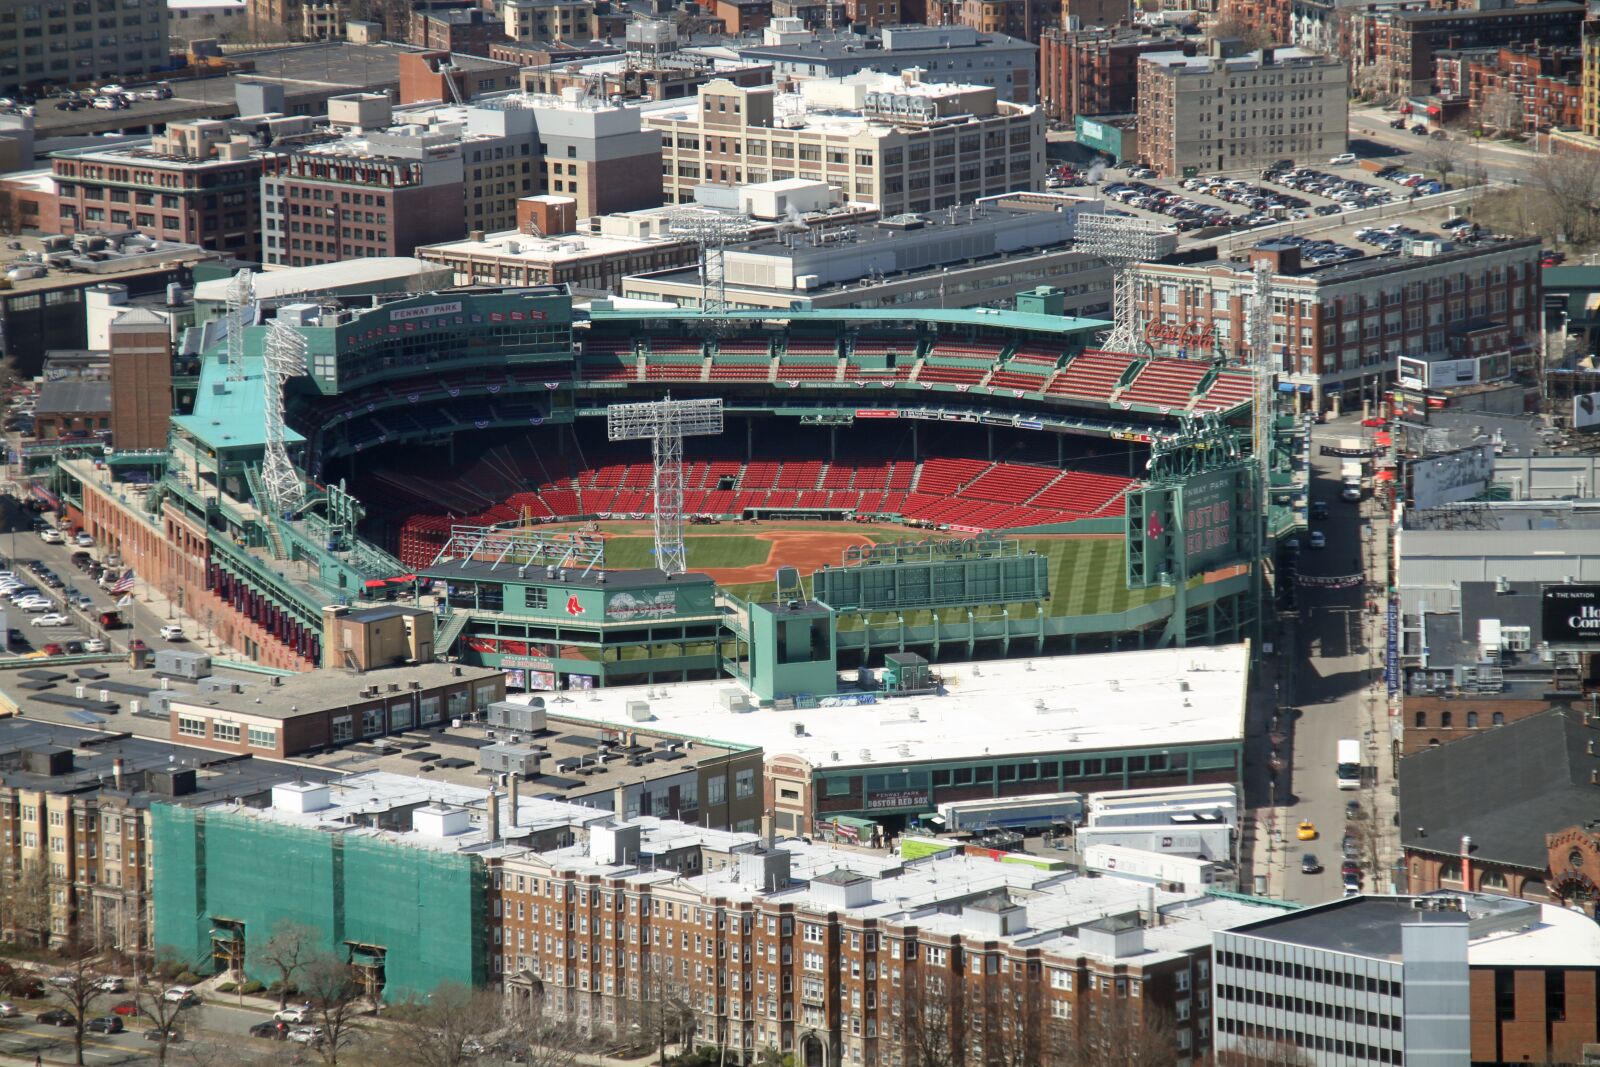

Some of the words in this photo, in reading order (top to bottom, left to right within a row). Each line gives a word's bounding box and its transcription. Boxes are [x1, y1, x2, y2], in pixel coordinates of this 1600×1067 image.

[394, 308, 429, 318] FENWAY
[433, 304, 457, 313] PARK
[868, 799, 896, 808] BOSTON
[897, 797, 912, 806] RED
[913, 796, 928, 804] SOX
